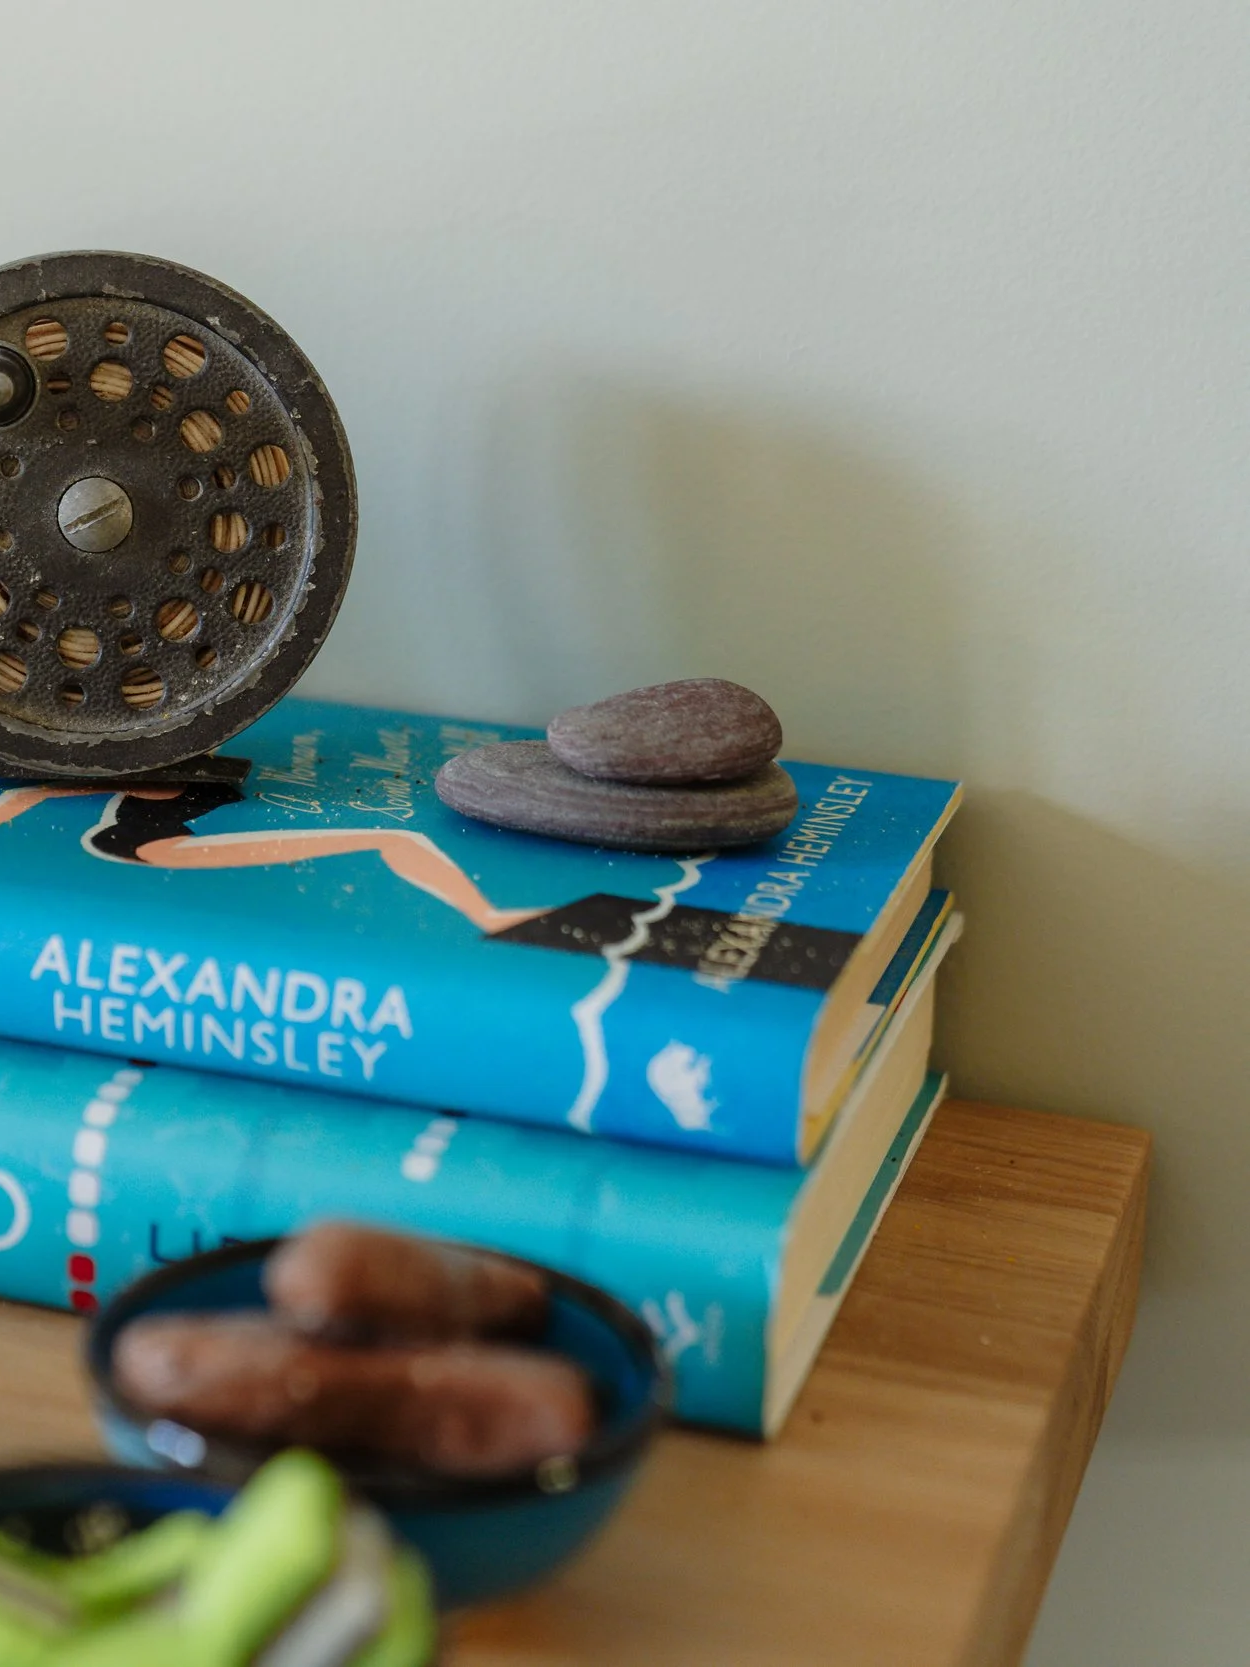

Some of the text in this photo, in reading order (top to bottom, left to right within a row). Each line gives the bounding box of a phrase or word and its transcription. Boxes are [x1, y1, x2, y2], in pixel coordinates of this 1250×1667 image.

[690, 774, 874, 995] ALEXANDRA HEMINSLEY
[30, 934, 414, 1040] ALEXANDRA
[52, 990, 389, 1081] HEMINSLEY
